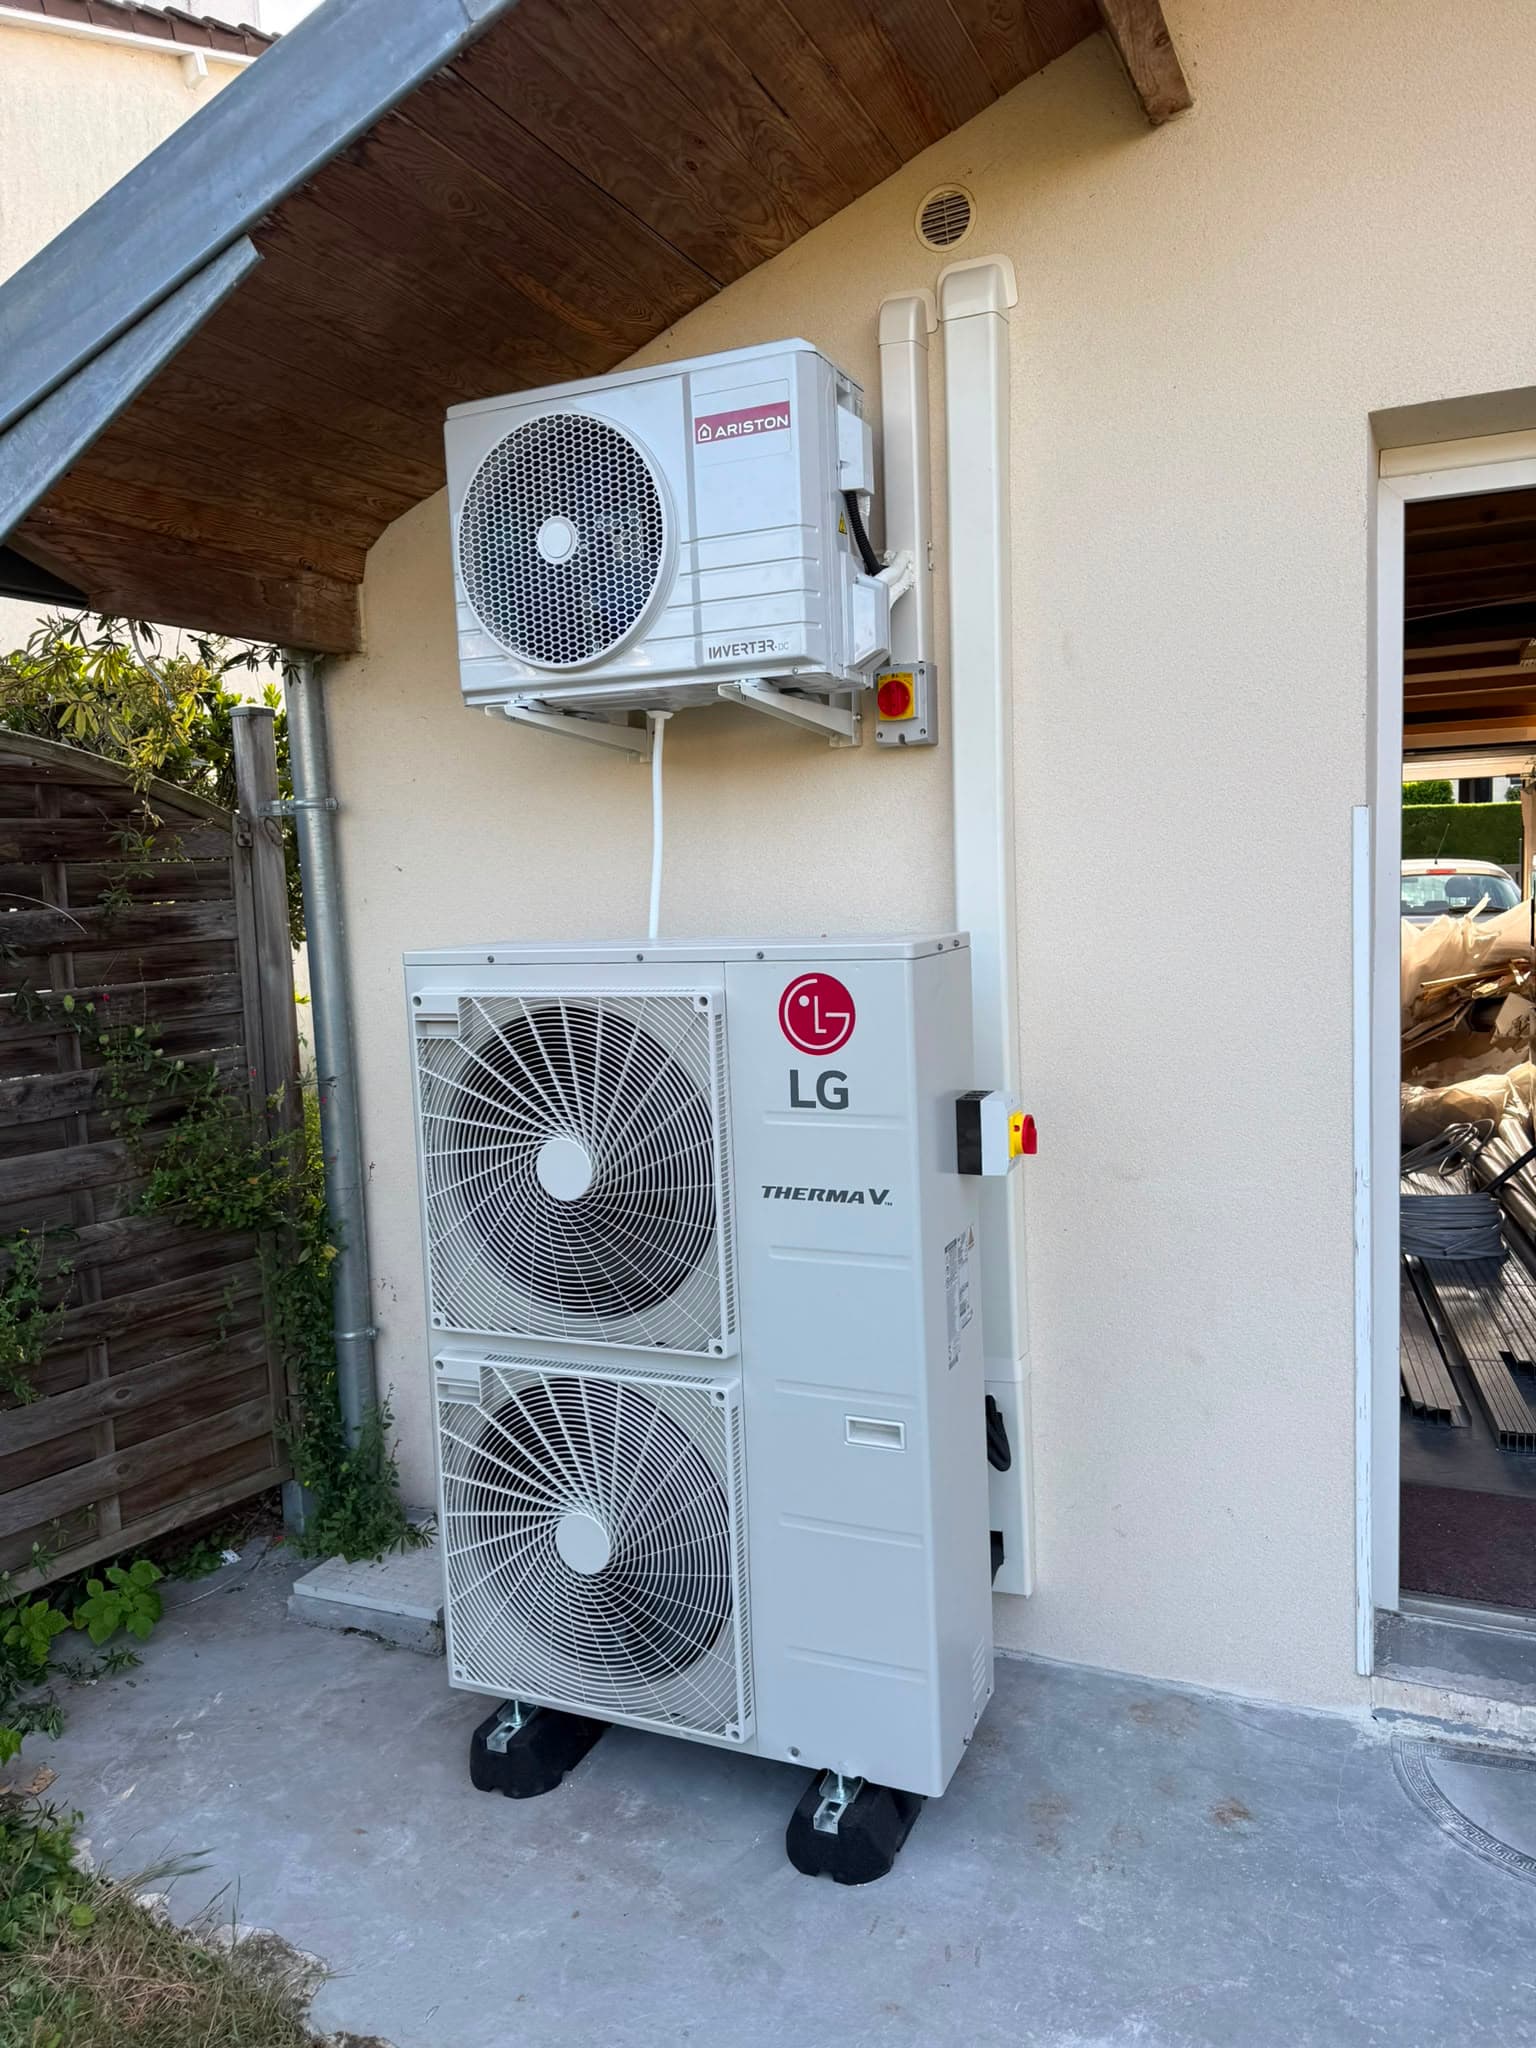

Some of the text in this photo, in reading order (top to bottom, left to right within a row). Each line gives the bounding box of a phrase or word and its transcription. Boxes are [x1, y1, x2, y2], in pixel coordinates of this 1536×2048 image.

[715, 414, 789, 438] ARISTON
[789, 1069, 849, 1110] LG
[761, 1185, 865, 1204] THERMA
